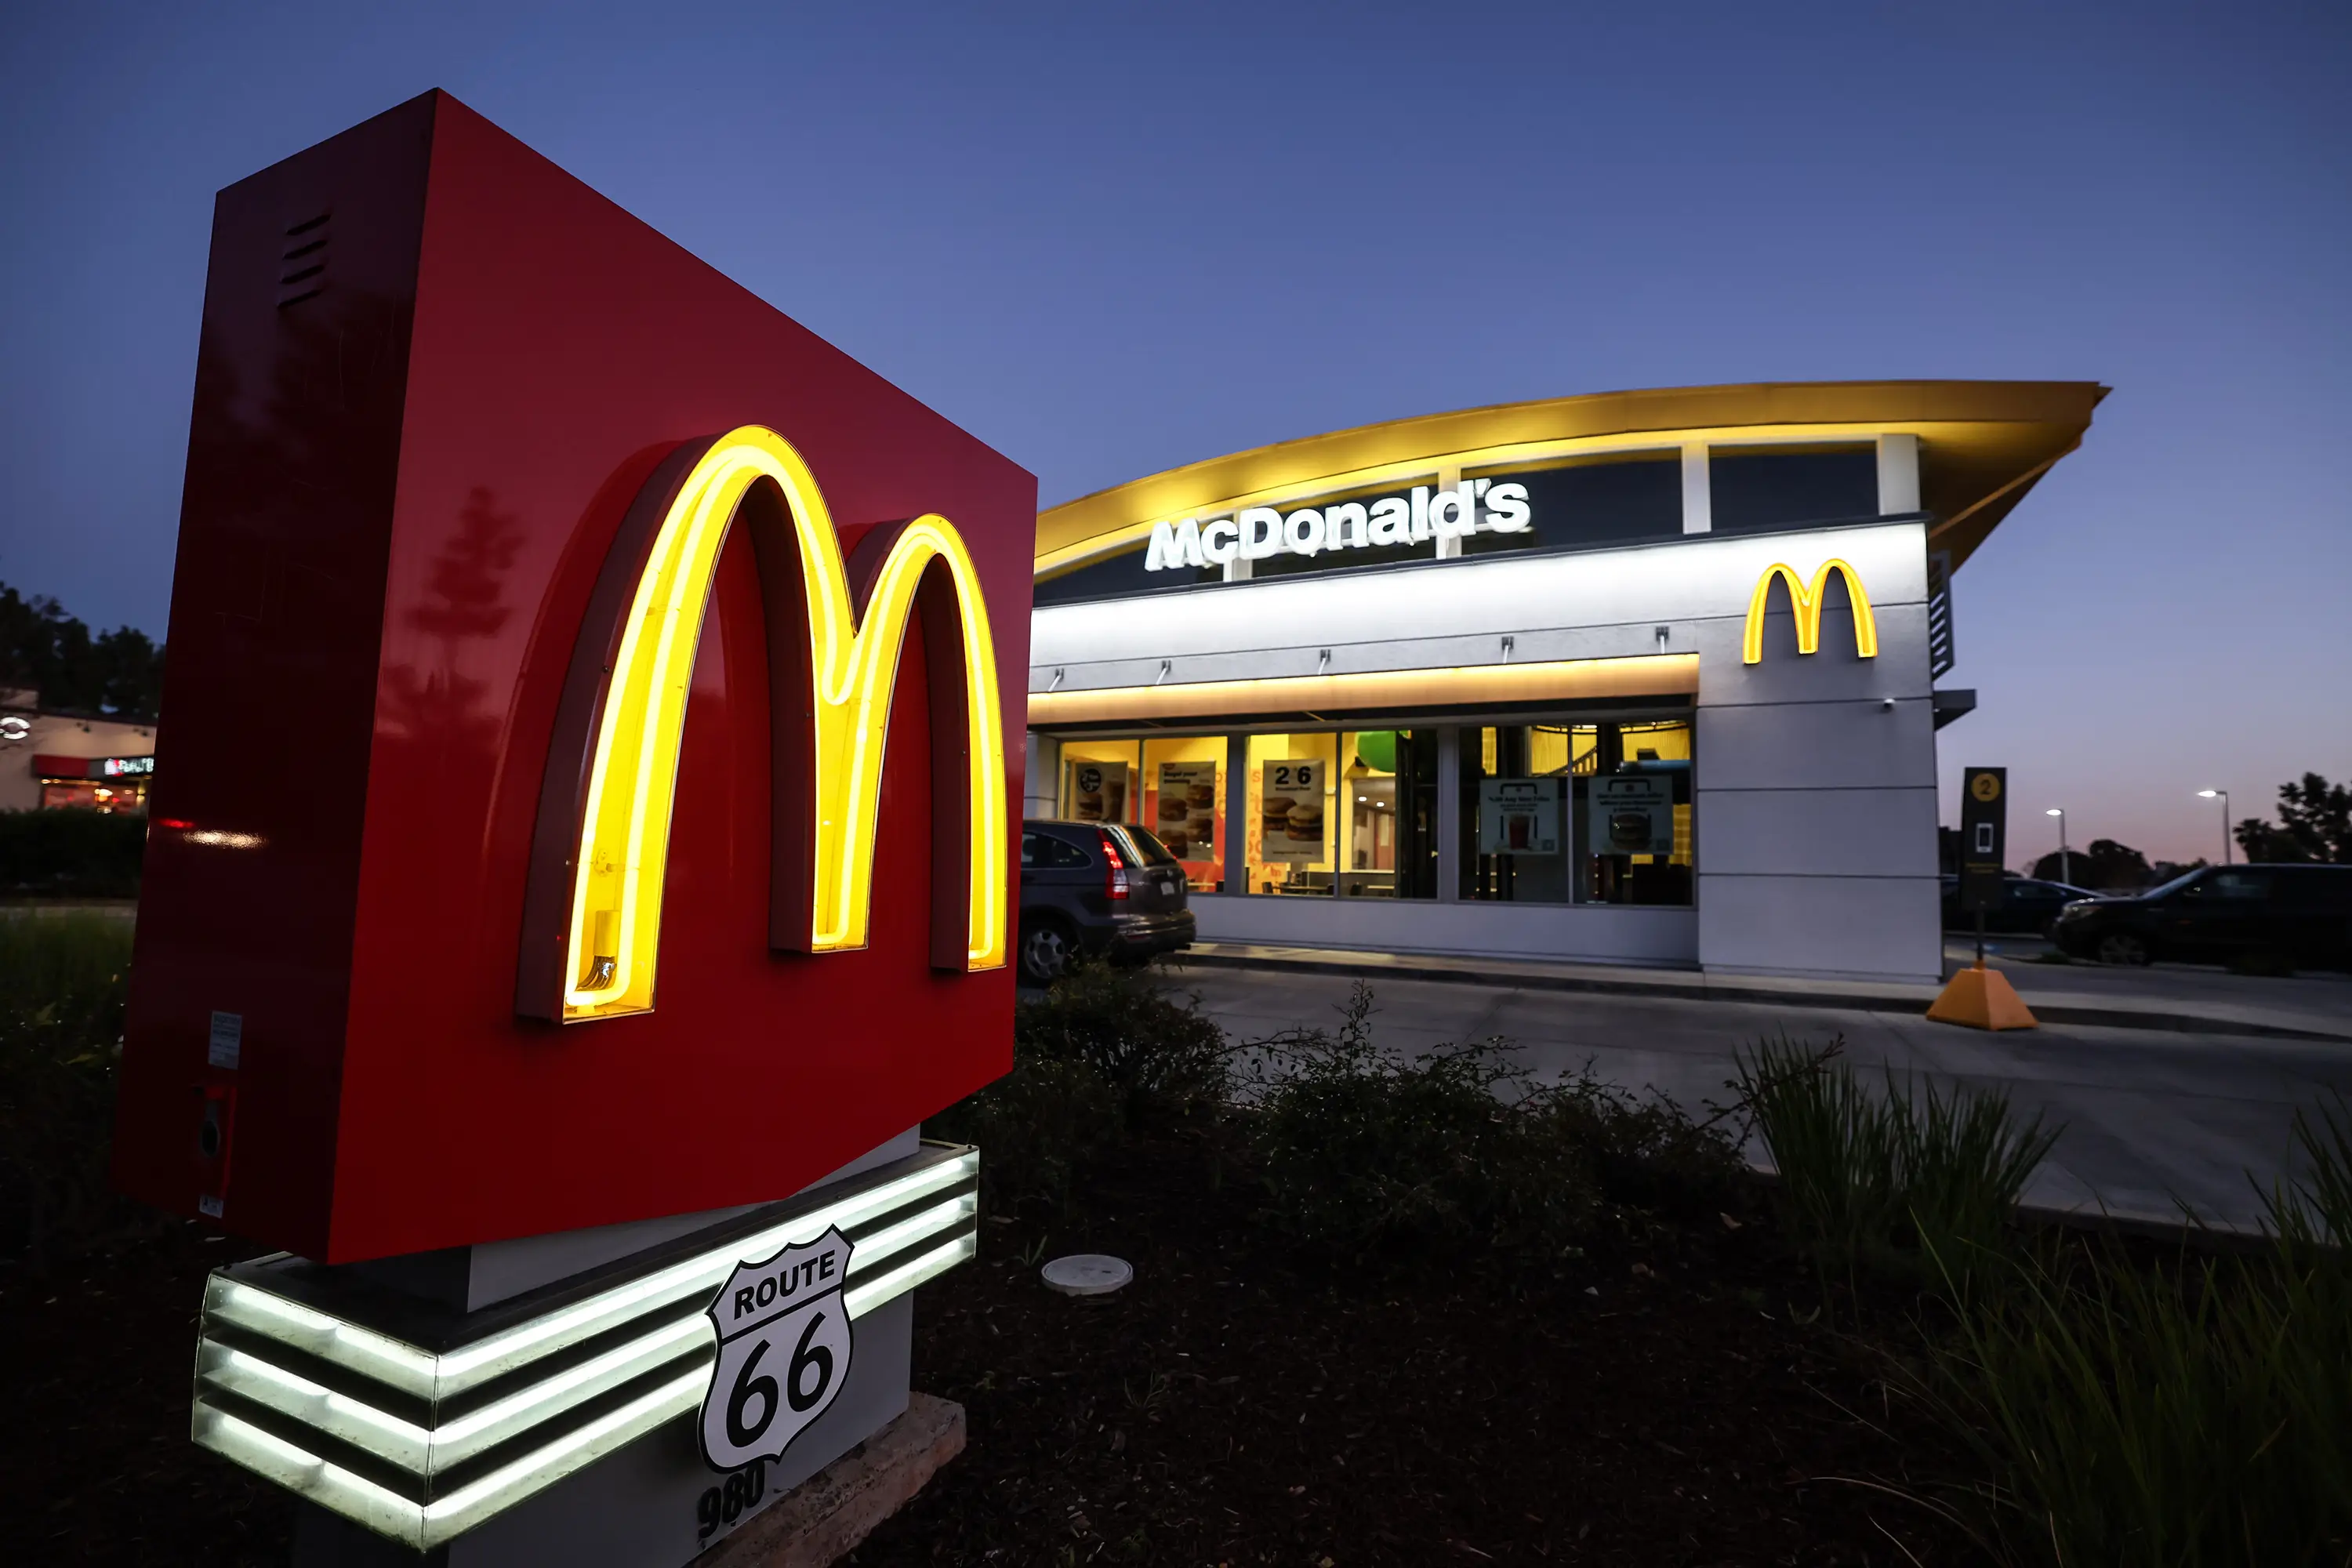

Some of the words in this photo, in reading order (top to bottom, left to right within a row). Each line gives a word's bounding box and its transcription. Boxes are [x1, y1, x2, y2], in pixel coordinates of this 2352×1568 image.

[1144, 478, 1532, 572] McDonald's
[1979, 779, 1992, 795] 2
[733, 1248, 837, 1320] ROUTE
[725, 1311, 834, 1448] 66
[697, 1461, 767, 1538] 980
